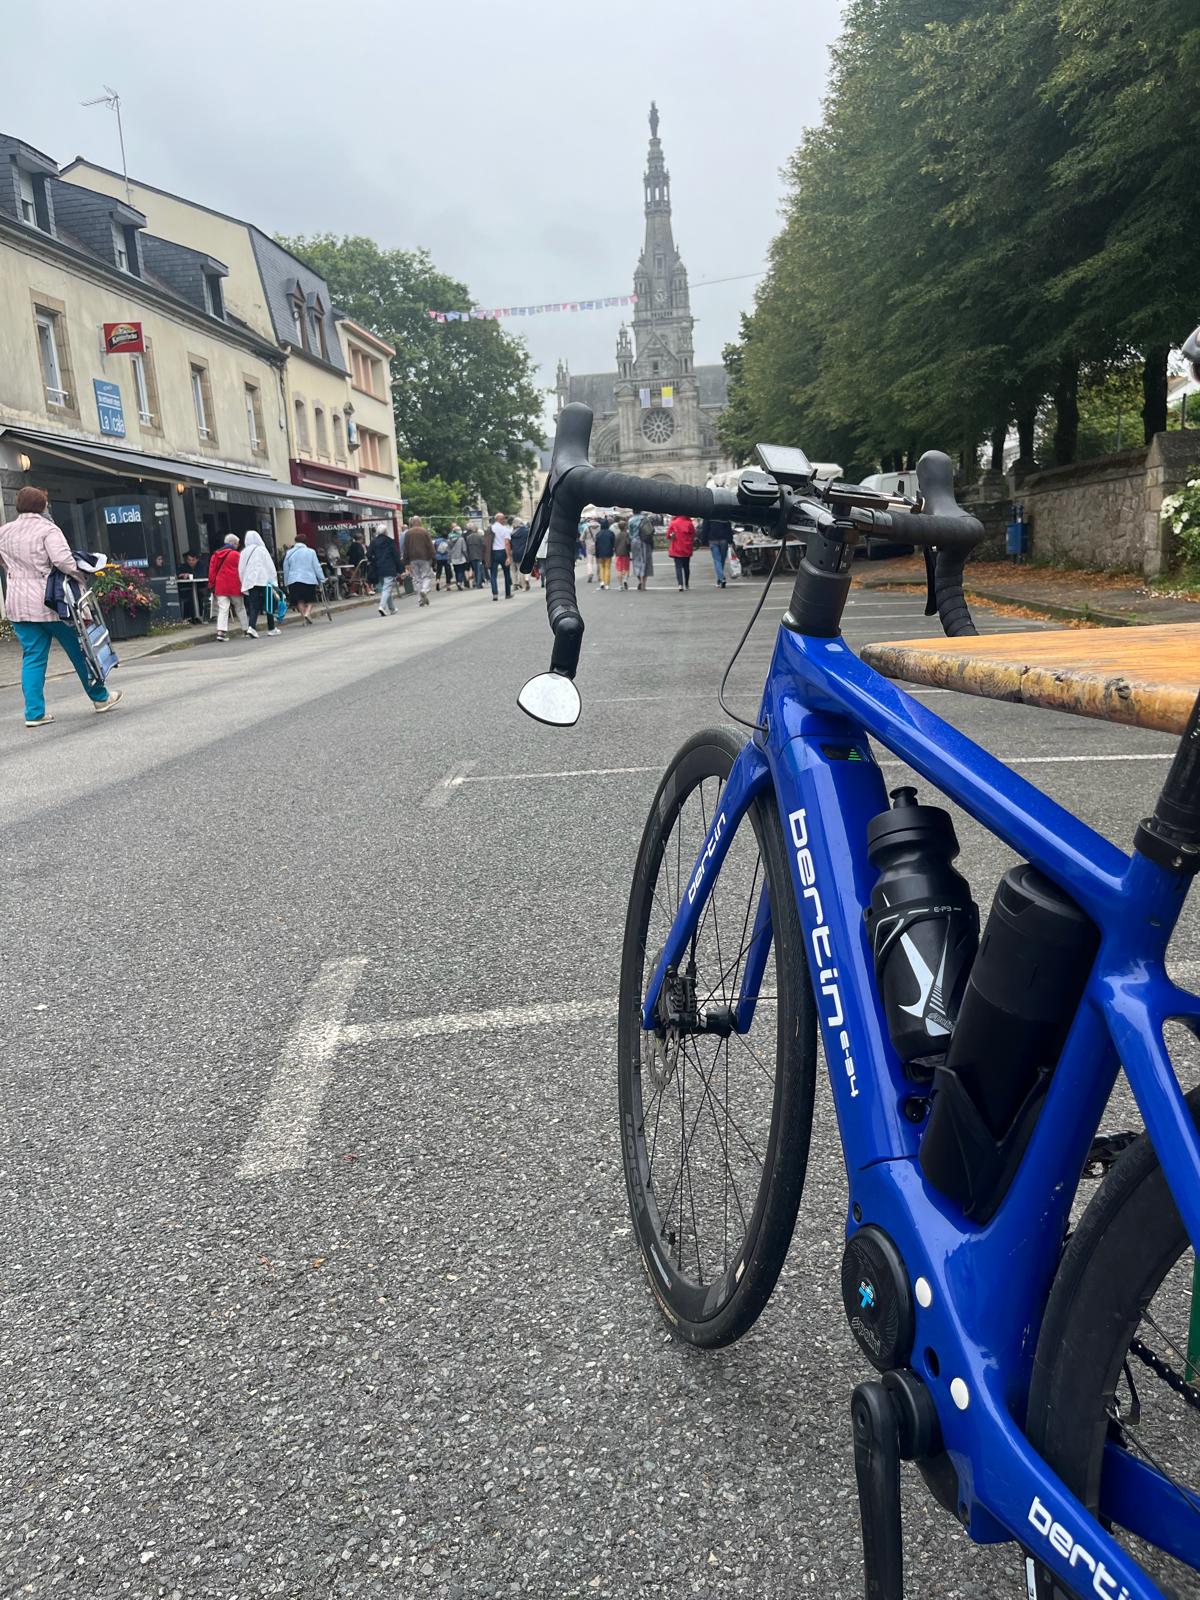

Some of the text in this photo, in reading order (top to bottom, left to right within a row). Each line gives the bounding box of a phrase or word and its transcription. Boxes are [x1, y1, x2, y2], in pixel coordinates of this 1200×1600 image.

[100, 409, 110, 430] La
[104, 507, 142, 525] La Scala
[317, 523, 348, 532] MAGASIN
[688, 812, 727, 905] bertin
[788, 808, 844, 1027] bertin
[1027, 1495, 1132, 1600] berti
